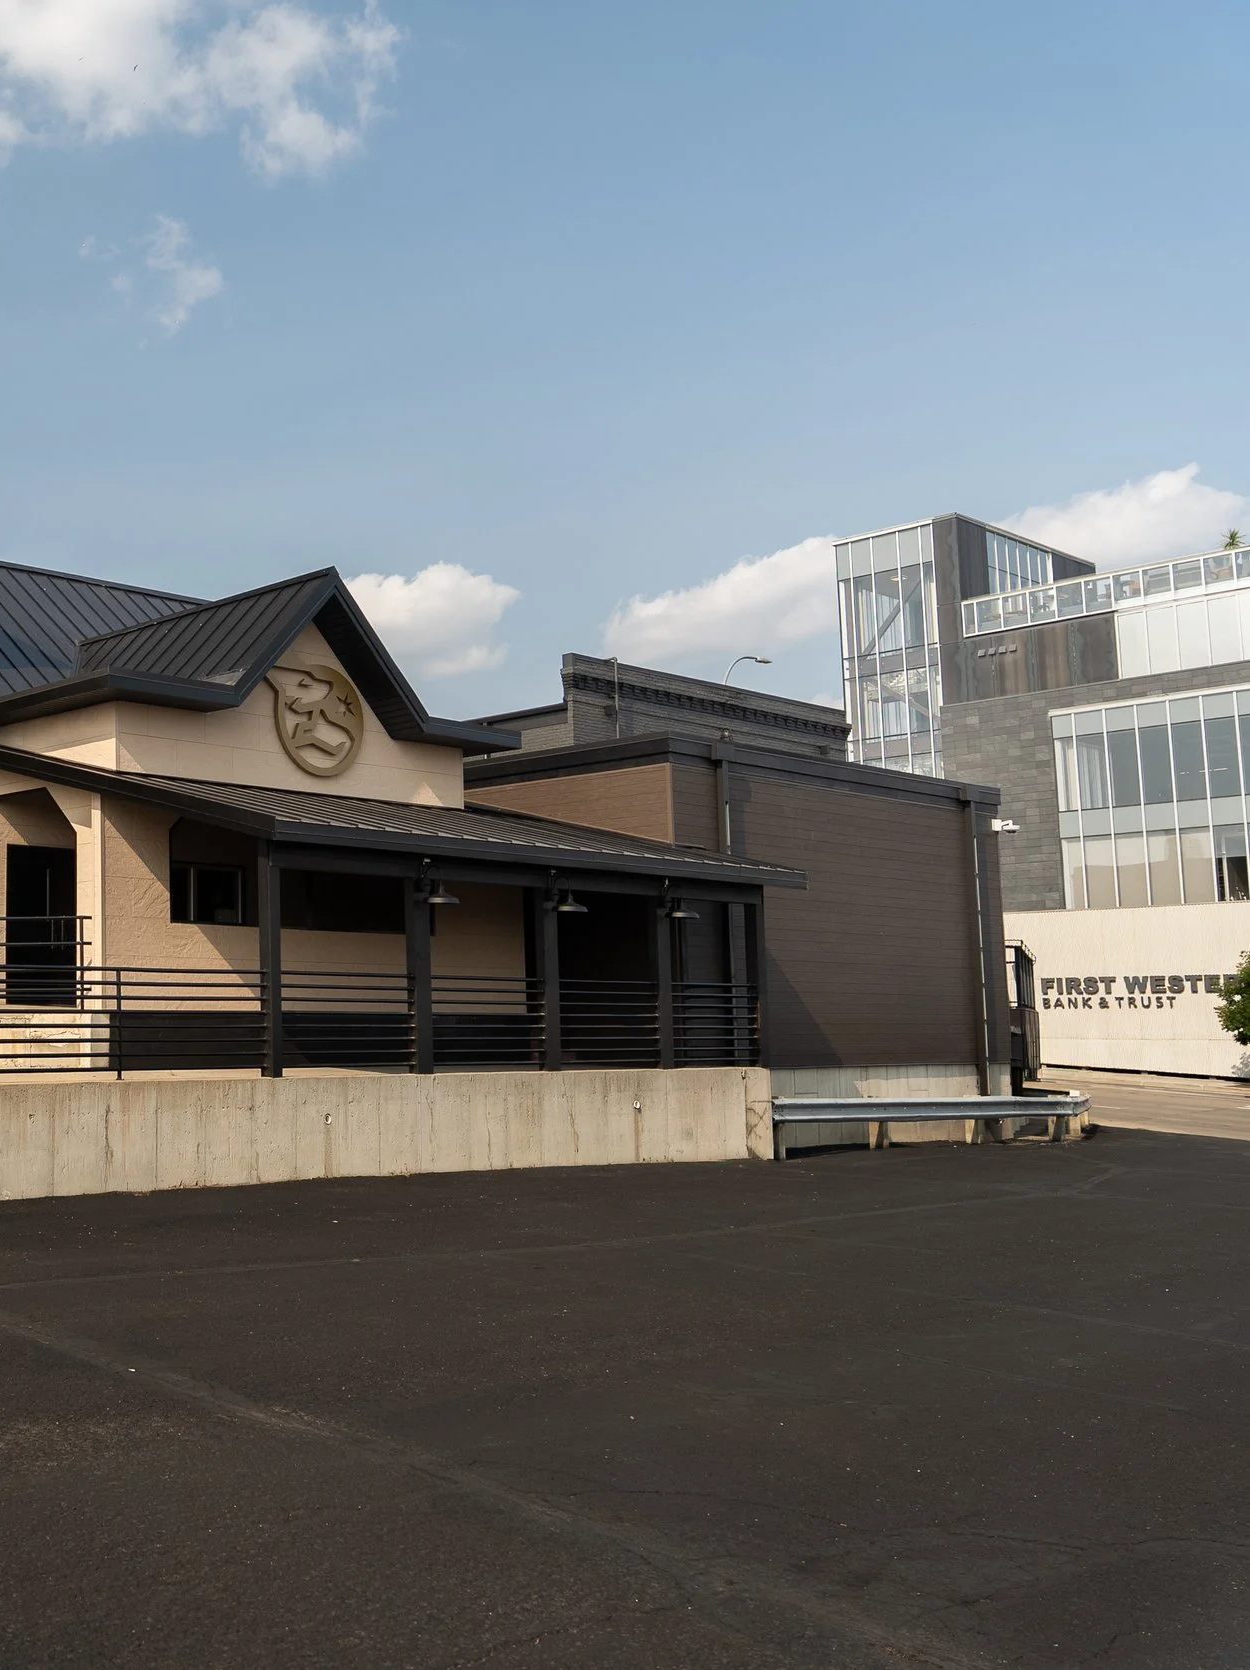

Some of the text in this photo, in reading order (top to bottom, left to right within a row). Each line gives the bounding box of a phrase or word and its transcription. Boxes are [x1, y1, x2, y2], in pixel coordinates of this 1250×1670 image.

[1041, 976, 1116, 995] FIRST
[1042, 996, 1176, 1009] BANK & TRUST
